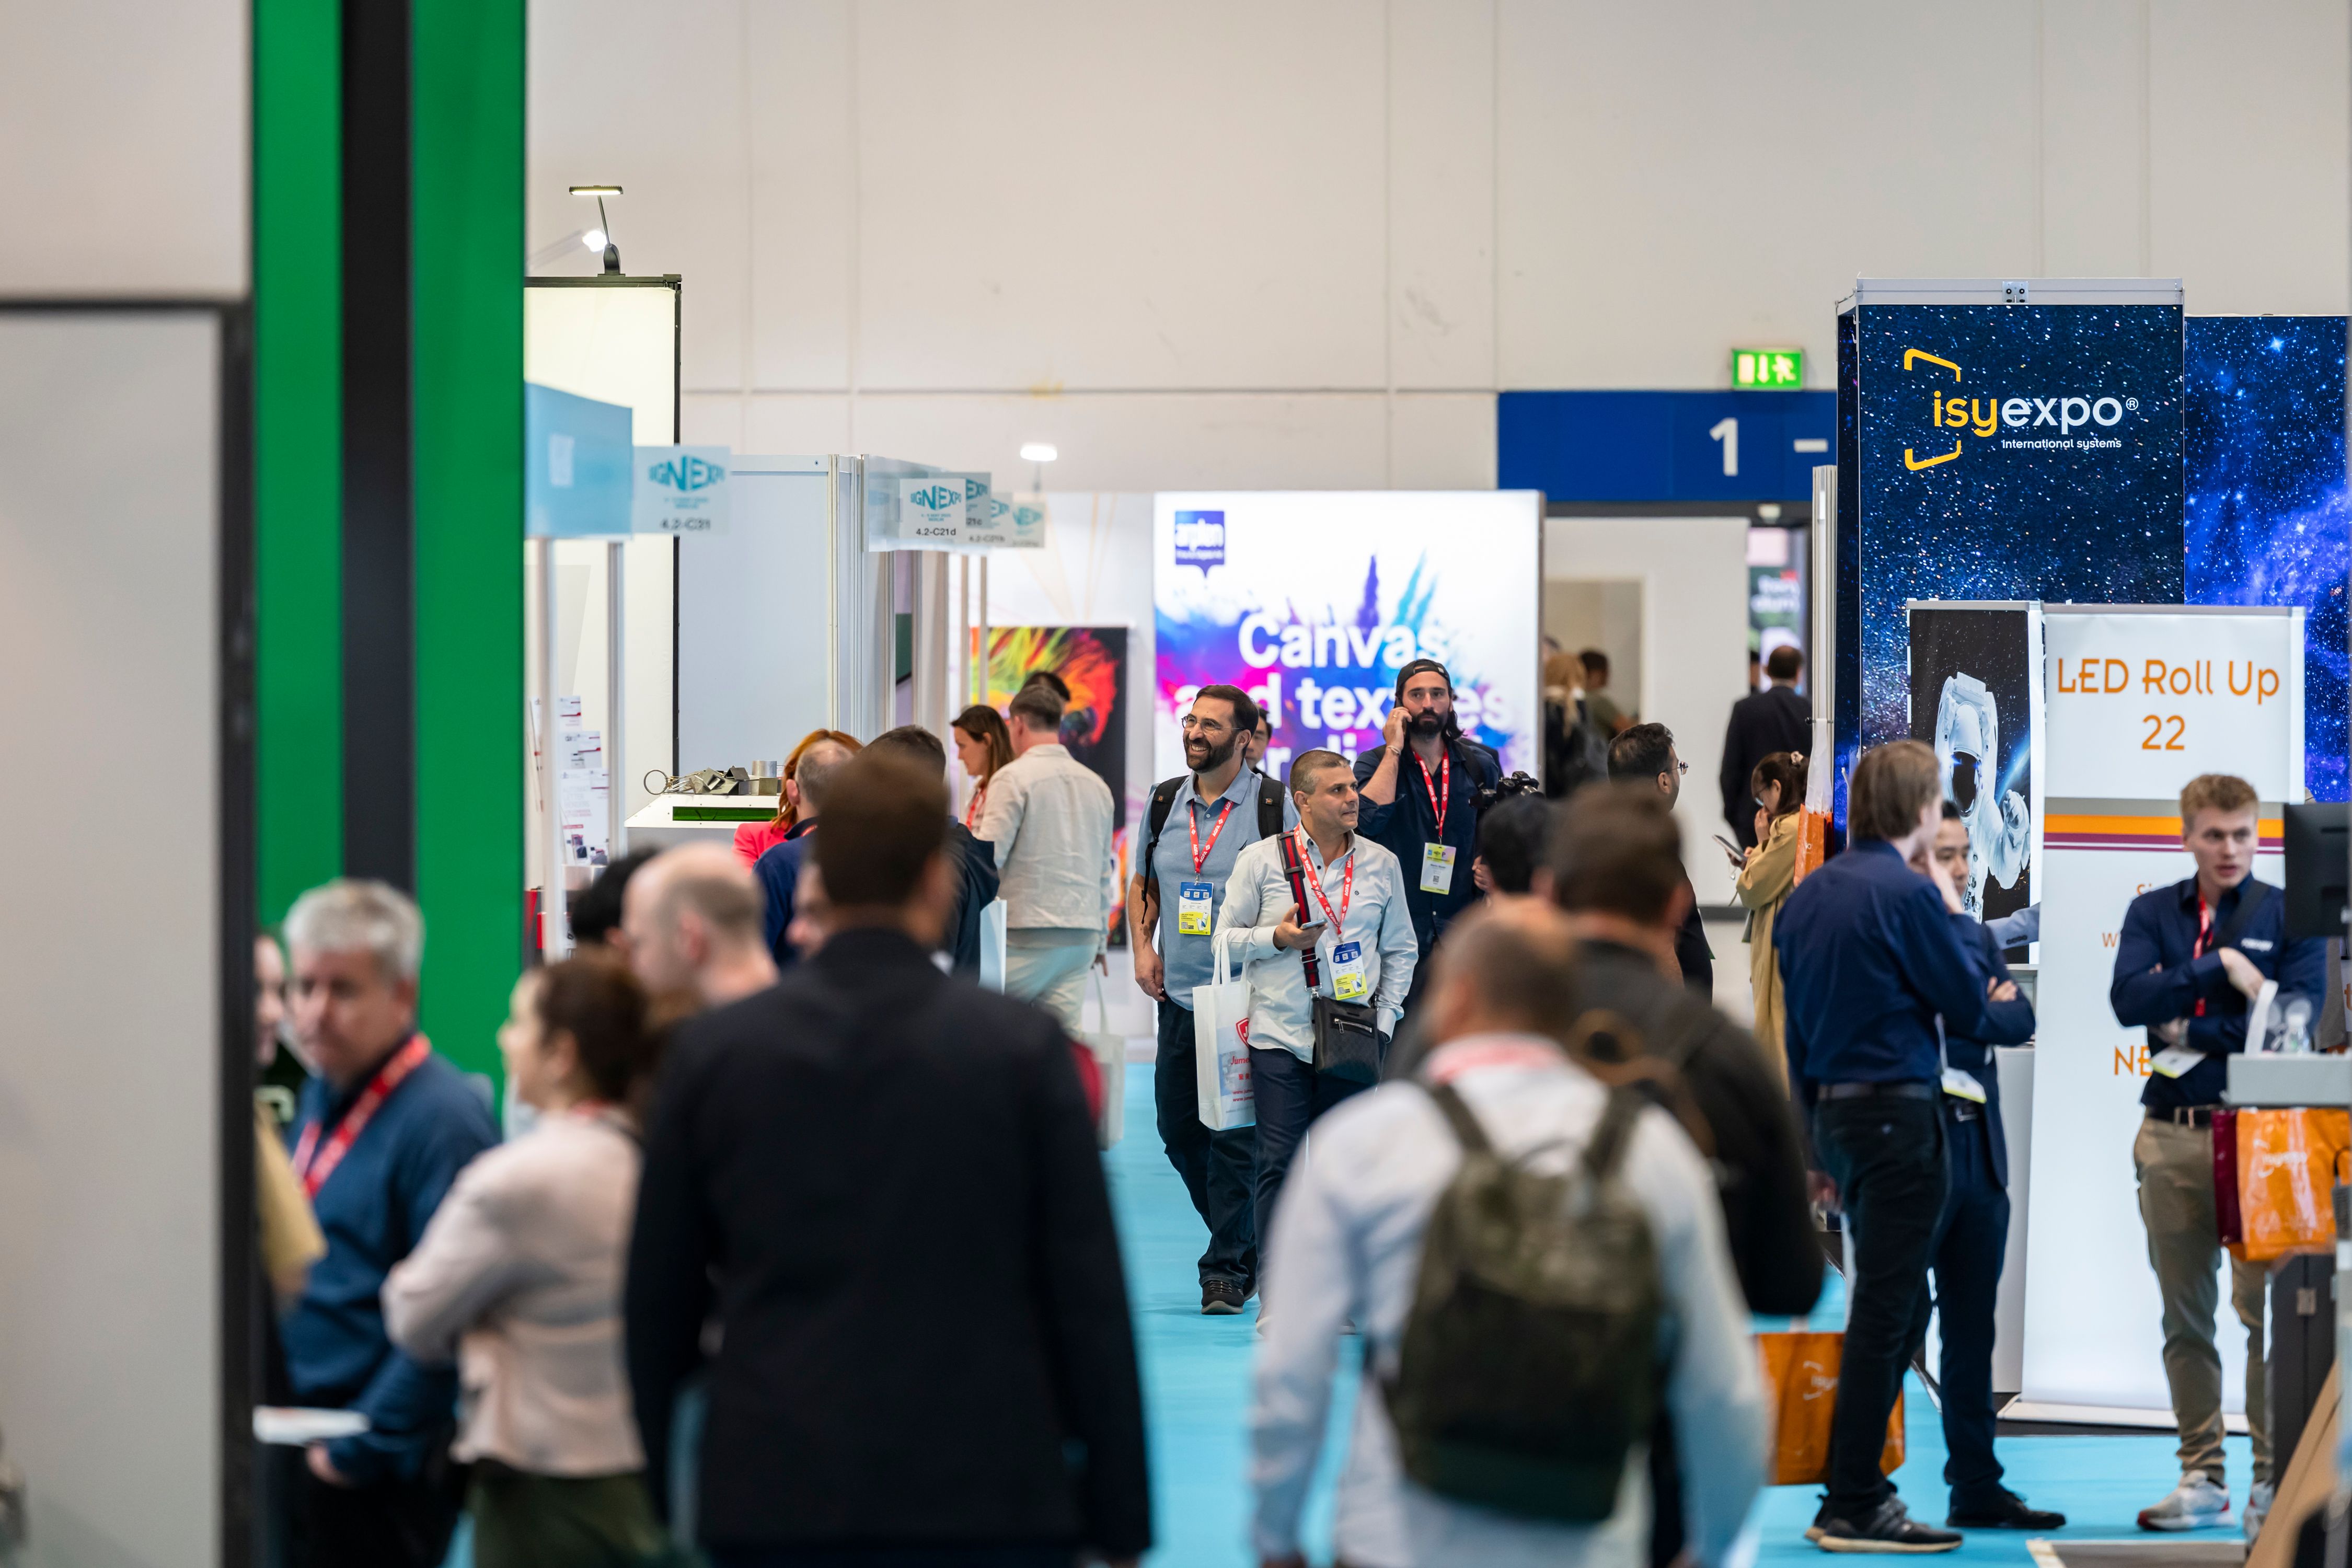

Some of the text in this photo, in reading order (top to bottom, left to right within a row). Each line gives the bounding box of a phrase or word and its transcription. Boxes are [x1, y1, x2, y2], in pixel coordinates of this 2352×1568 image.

[2002, 438, 2122, 451] international systems
[916, 527, 956, 536] 4.2-C21d
[1238, 613, 1449, 668] Canvas
[2057, 658, 2280, 705] LED Roll Up
[2141, 714, 2185, 750] 22
[1212, 825, 1220, 837] AGFA
[1200, 851, 1208, 863] AGFA
